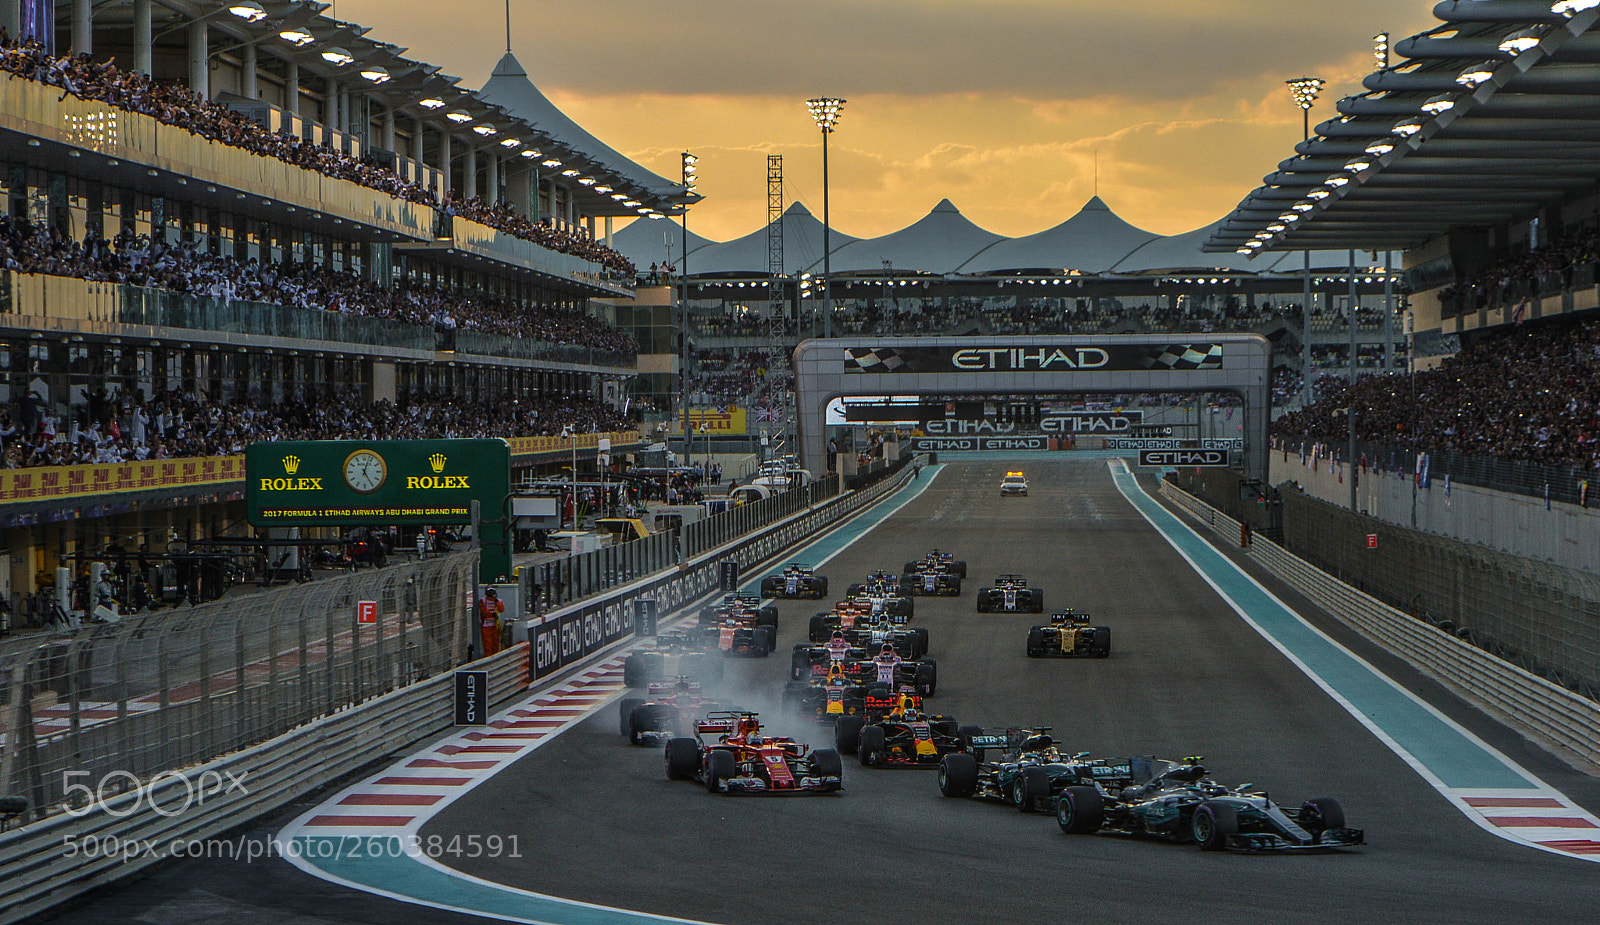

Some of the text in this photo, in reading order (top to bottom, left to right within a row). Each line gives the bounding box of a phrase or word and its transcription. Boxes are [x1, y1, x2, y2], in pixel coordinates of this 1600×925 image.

[952, 347, 1110, 369] ETIHAD
[680, 420, 731, 430] RLLI
[1040, 416, 1130, 432] ETIHAD
[917, 440, 971, 450] ETIHAD
[986, 439, 1041, 449] ETIHAD
[1145, 452, 1222, 464] ETIHAD
[260, 478, 324, 491] ROLEX
[406, 476, 471, 489] ROLEX
[263, 510, 282, 518] 2017
[324, 509, 351, 517] ETIHAD
[363, 605, 373, 621] F
[604, 602, 621, 637] ETIHAD
[641, 602, 649, 635] ETIHAD
[584, 610, 602, 647] ETIHAD
[561, 619, 581, 657] ETIHAD
[536, 627, 558, 669] ETIHAD
[467, 674, 476, 722] ETIHAD
[866, 696, 894, 708] Red
